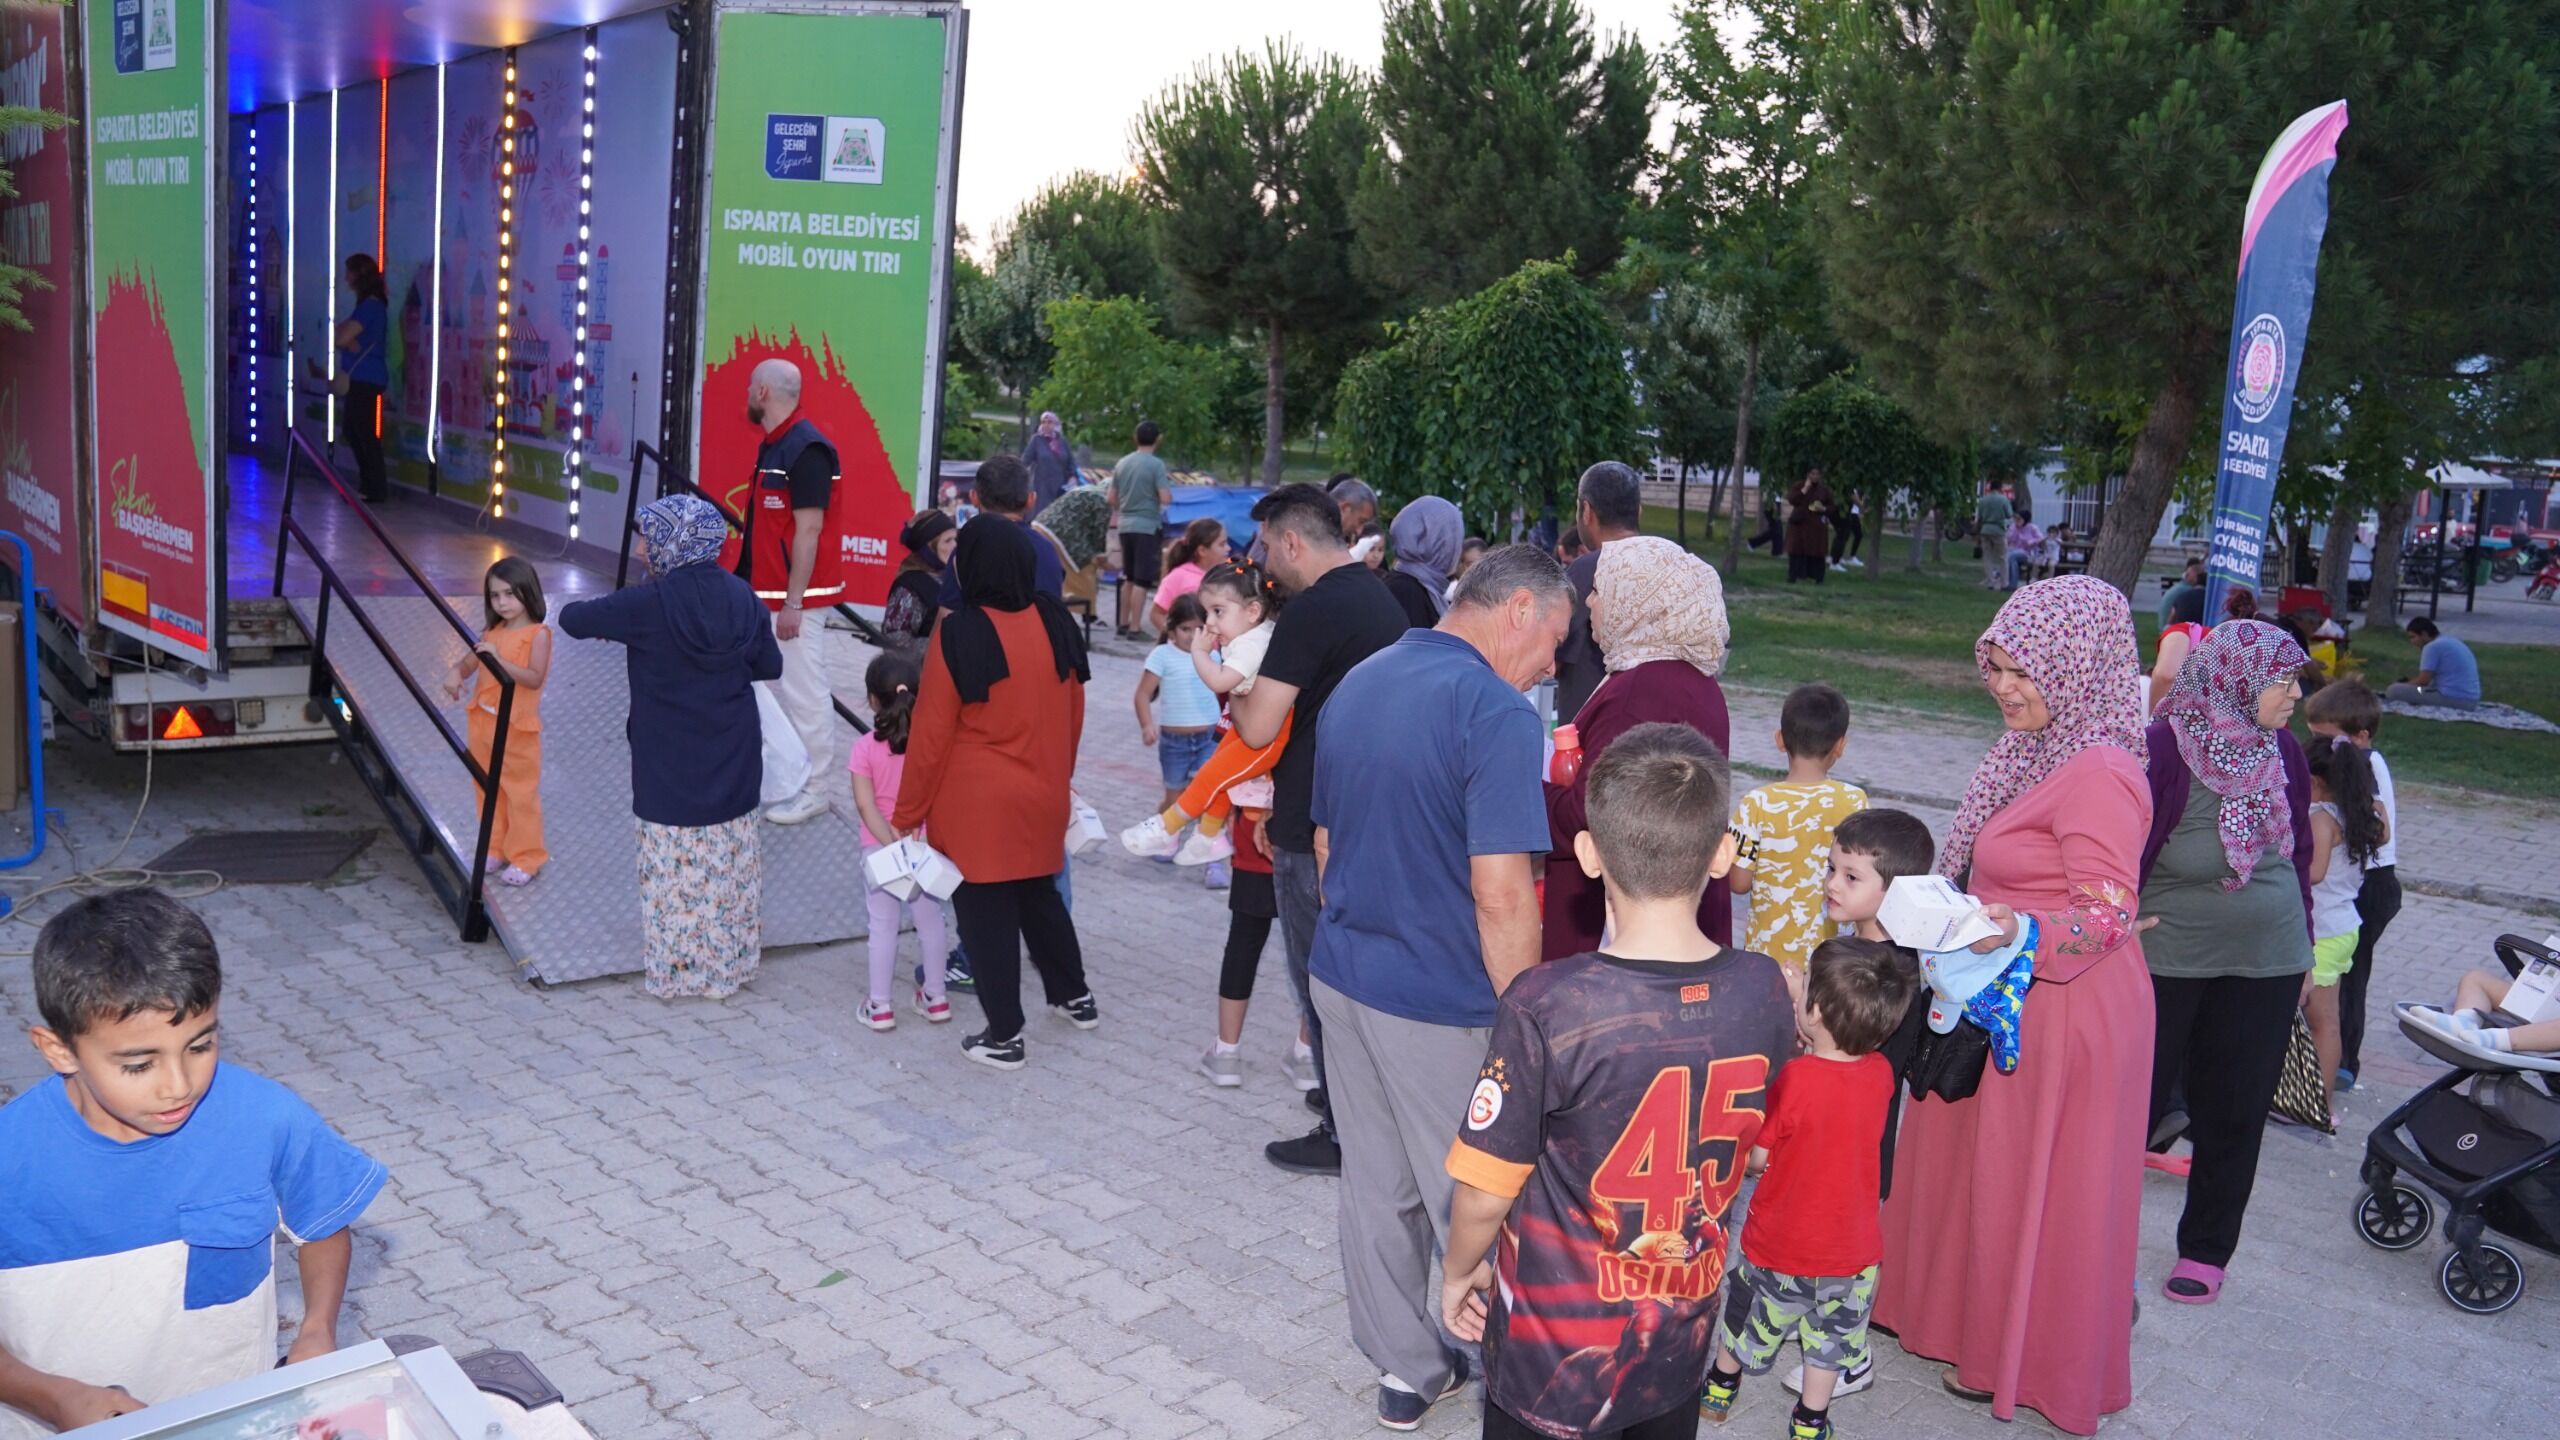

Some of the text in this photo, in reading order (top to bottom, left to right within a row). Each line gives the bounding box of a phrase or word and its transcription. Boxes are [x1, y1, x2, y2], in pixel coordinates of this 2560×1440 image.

[96, 103, 199, 143] ISPARTA BELEDİYESİ
[774, 122, 818, 137] GELECEĞİN
[105, 153, 190, 186] MOBİL OYUN TIRI
[723, 208, 921, 241] ISPARTA BELEDİYESİ
[737, 241, 901, 275] MOBİL OYUN TIRI
[2250, 321, 2280, 343] ISPARTA
[118, 509, 194, 553] BAŞDEĞİRMEN
[852, 554, 888, 566] Başkanı
[1680, 983, 1710, 1004] 1905
[1591, 1054, 1770, 1233] 45
